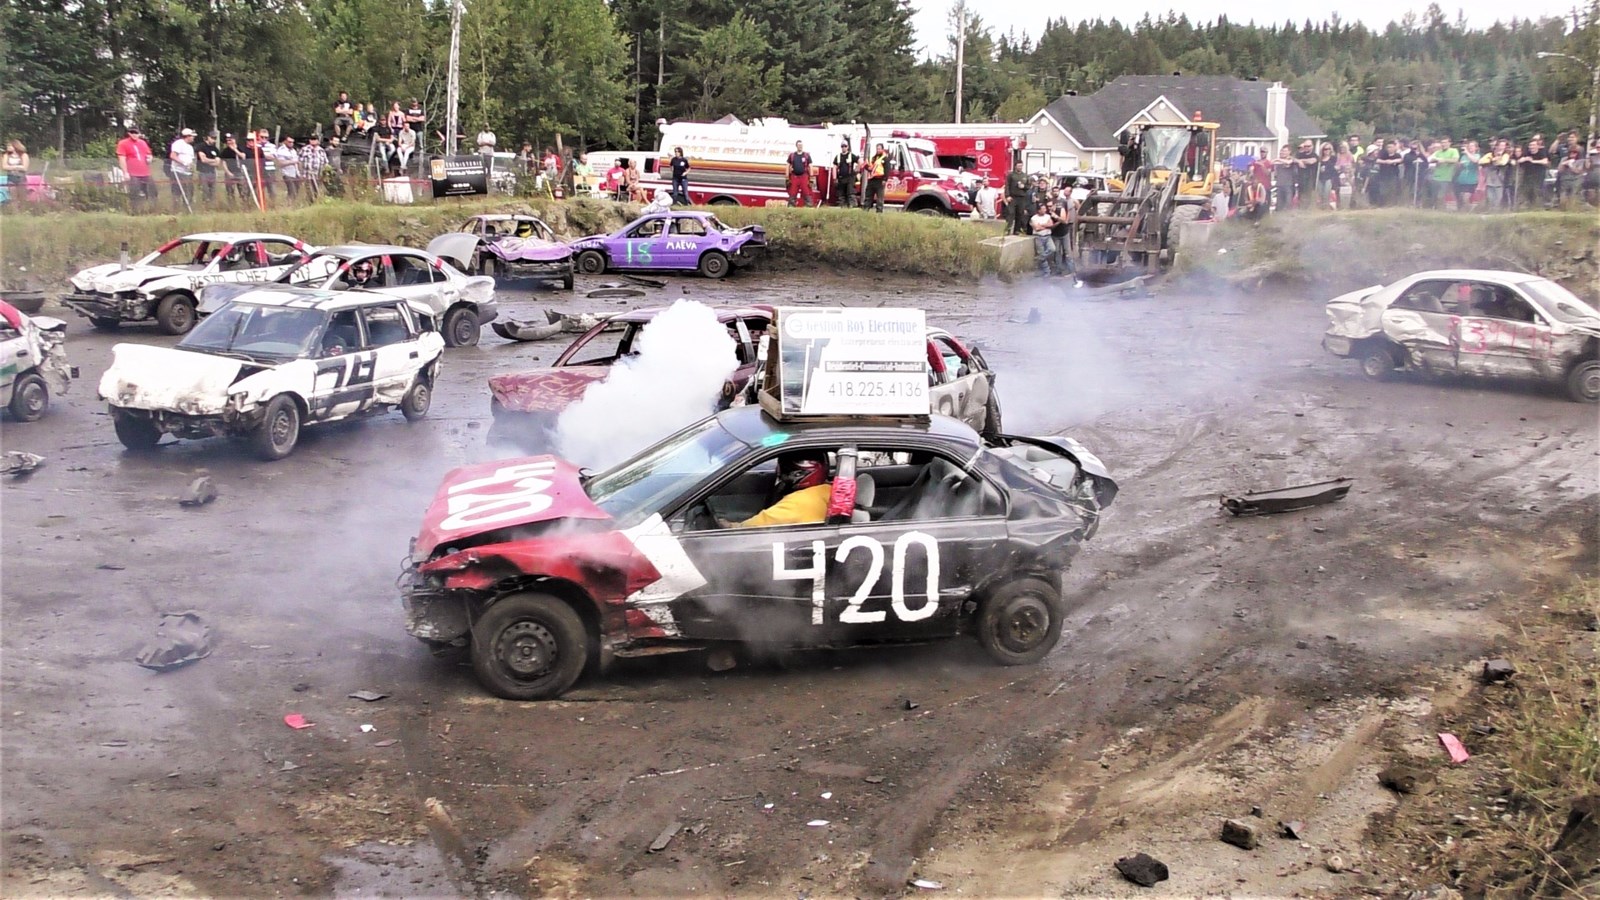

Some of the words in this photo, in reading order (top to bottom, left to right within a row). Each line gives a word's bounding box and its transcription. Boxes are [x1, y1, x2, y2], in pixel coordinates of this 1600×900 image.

[847, 320, 866, 335] Roy
[828, 381, 922, 397] 418.225.4136
[772, 531, 941, 625] 420
